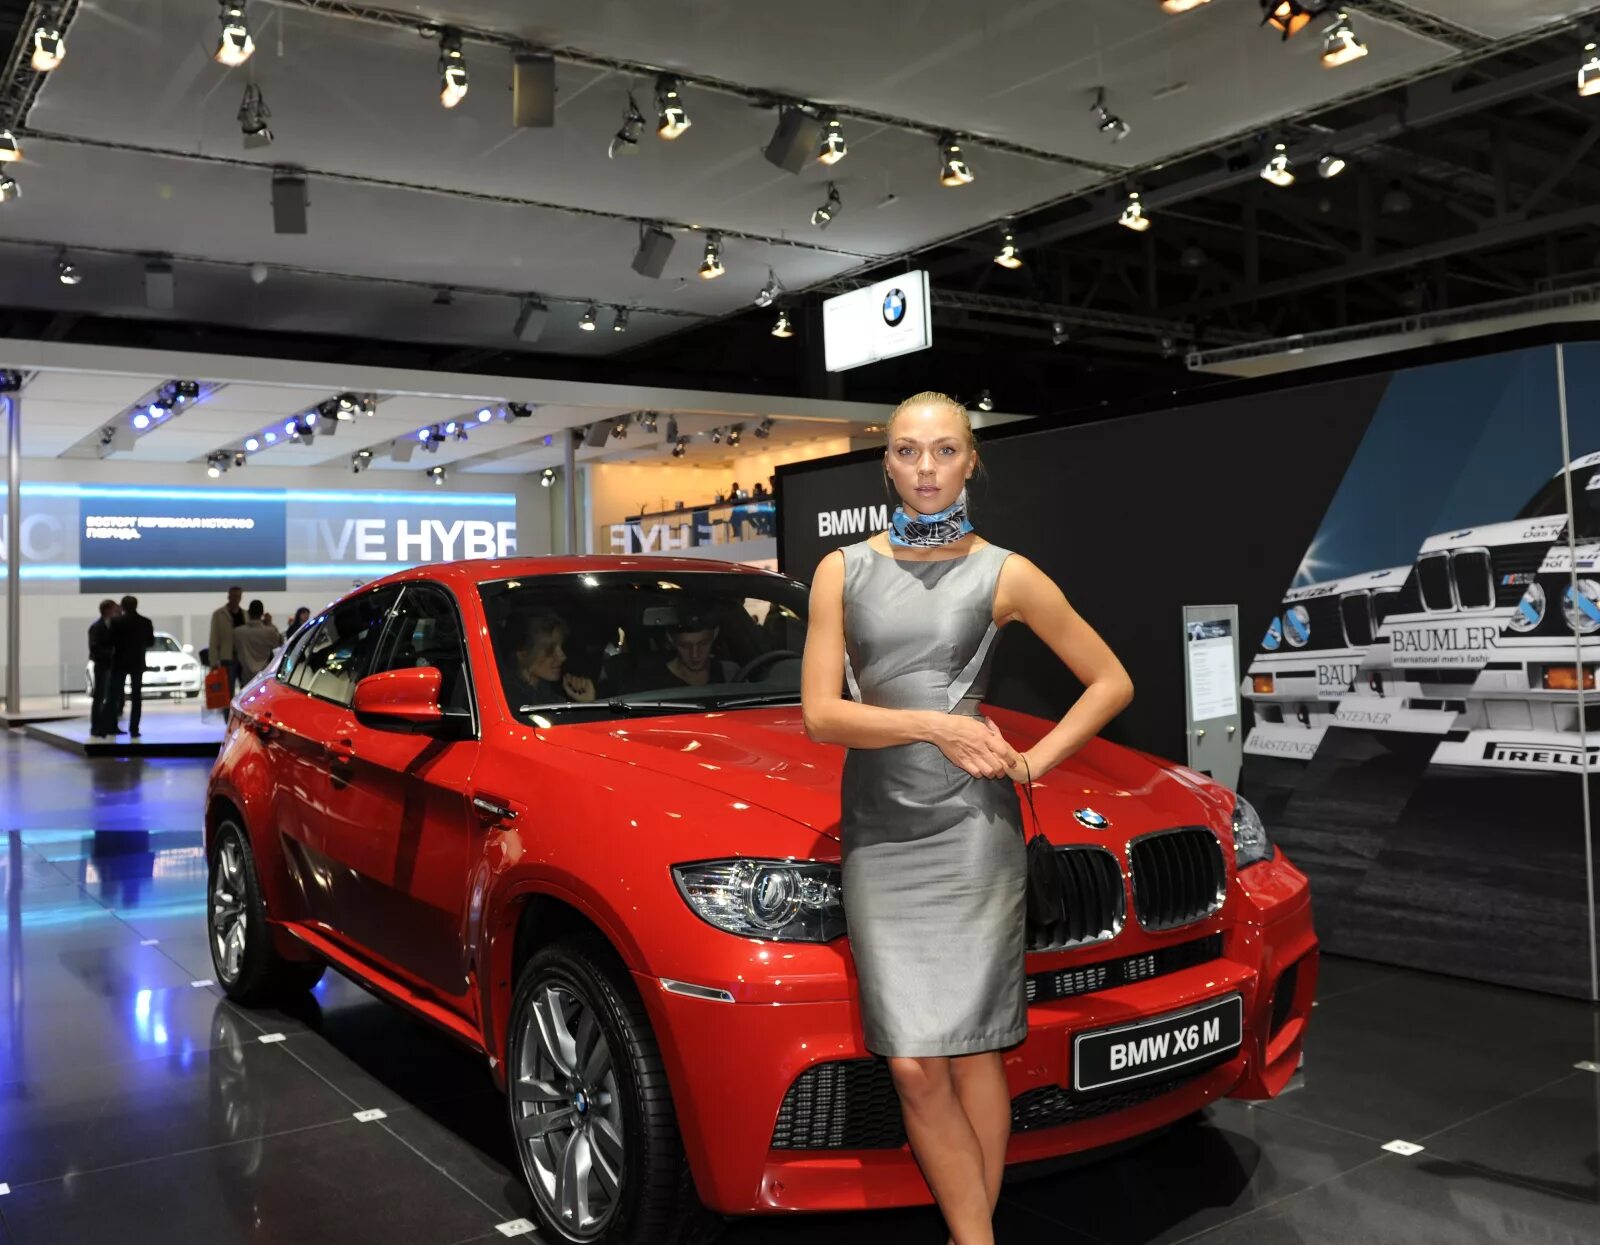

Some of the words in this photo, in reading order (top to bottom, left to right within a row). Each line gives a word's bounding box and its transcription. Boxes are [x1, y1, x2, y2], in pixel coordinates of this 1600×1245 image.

[818, 507, 865, 537] BMW
[1483, 741, 1600, 766] PIRELLI
[1110, 1032, 1170, 1071] BMW
[1173, 1024, 1199, 1055] X6
[1203, 1017, 1220, 1045] M
